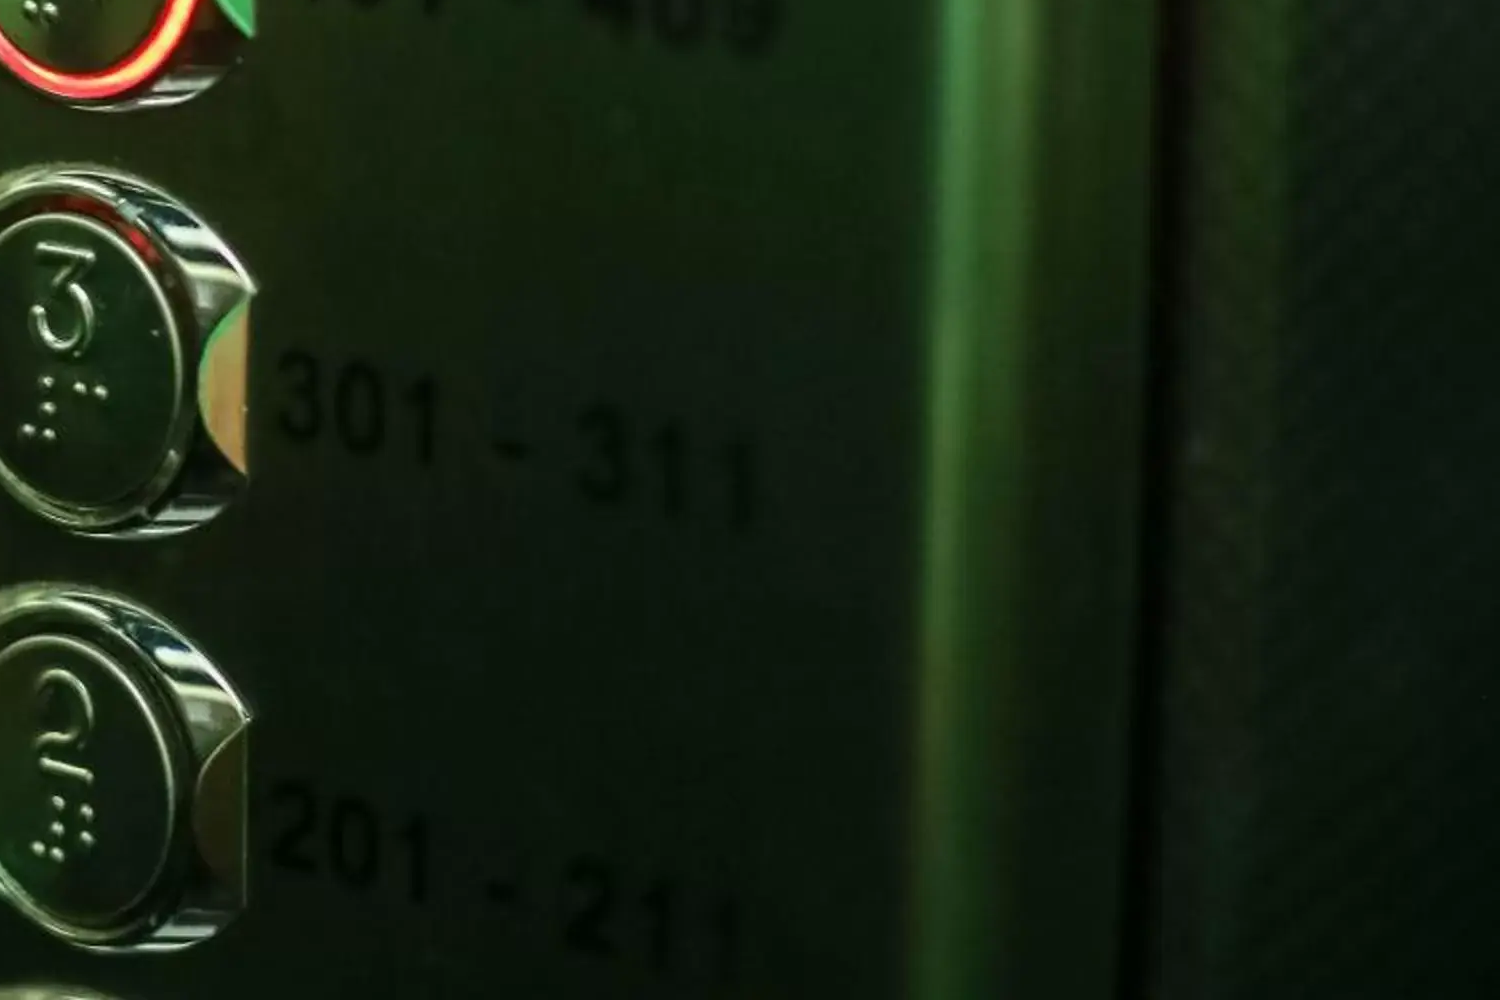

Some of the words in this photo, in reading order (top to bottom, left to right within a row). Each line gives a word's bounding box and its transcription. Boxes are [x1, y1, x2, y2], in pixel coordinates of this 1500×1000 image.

[27, 240, 97, 358] 3
[277, 350, 437, 467] 301
[576, 402, 758, 532] 311
[33, 666, 96, 785] 2
[271, 781, 427, 903] 201
